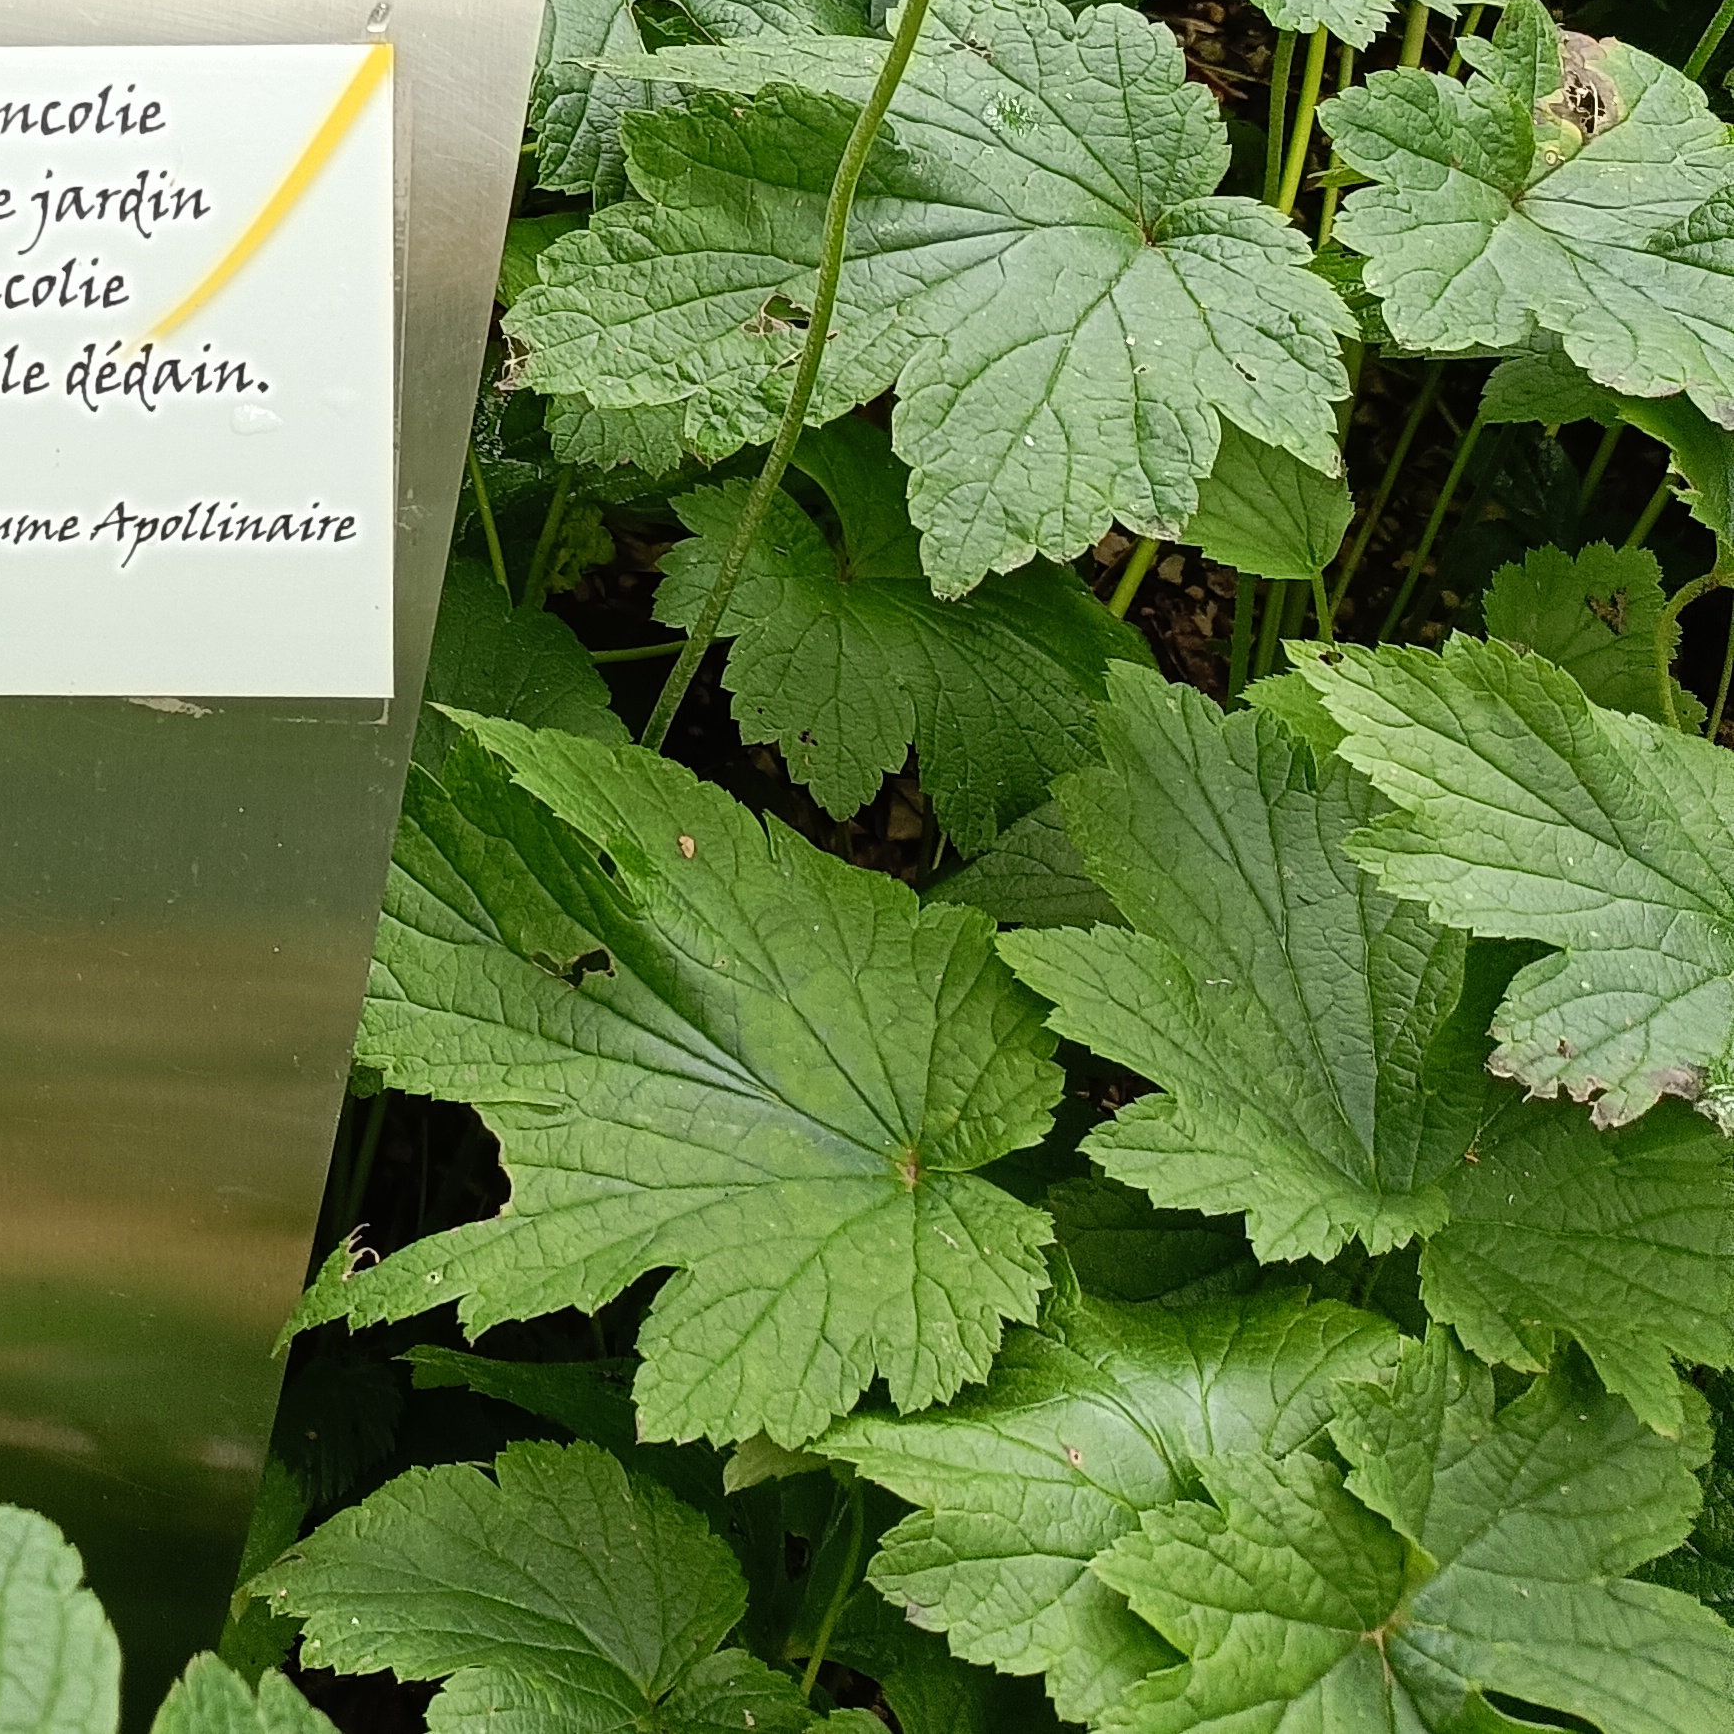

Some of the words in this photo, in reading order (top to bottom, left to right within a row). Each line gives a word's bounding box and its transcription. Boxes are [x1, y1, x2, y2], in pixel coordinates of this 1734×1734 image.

[16, 168, 212, 257] jardin
[0, 343, 51, 396] le
[65, 339, 270, 414] dédain.
[88, 500, 358, 569] Apollinaire
